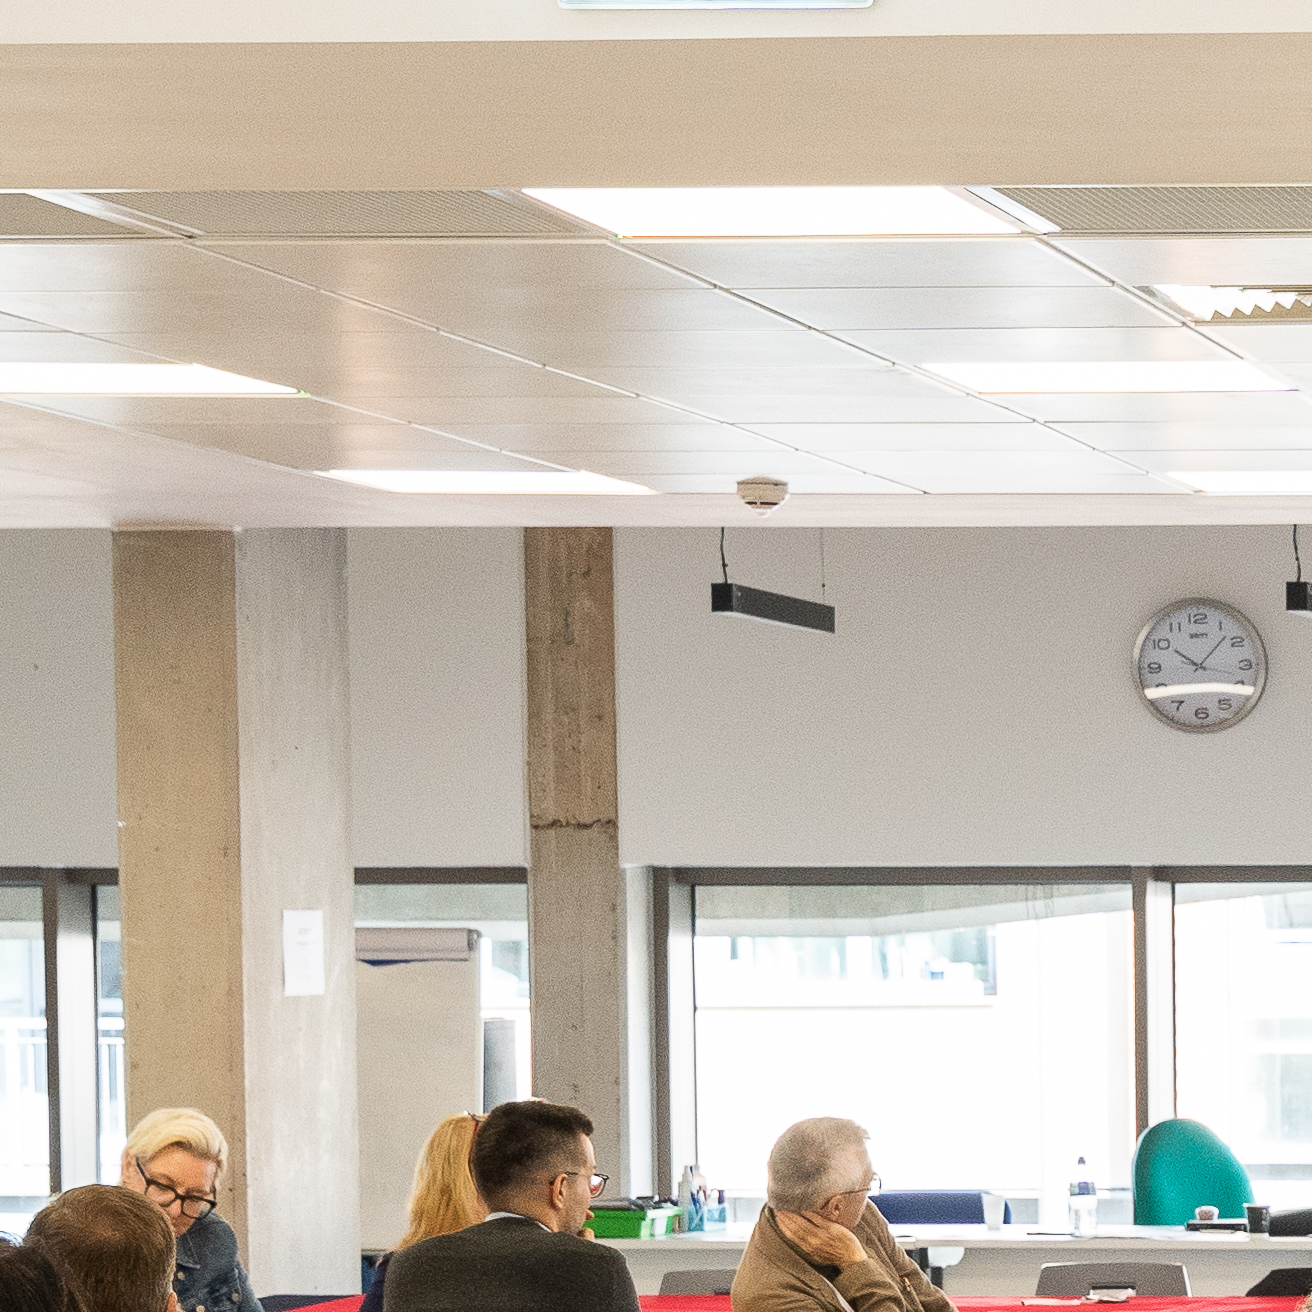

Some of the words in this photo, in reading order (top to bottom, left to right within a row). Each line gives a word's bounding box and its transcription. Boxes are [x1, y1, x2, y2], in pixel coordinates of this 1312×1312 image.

[1188, 612, 1208, 625] 12
[1169, 622, 1182, 633] 11
[1152, 638, 1171, 650] 10
[1230, 636, 1245, 648] 2
[1148, 662, 1162, 674] 9
[1238, 659, 1252, 671] 3
[1171, 700, 1185, 711] 7
[1218, 698, 1232, 711] 5
[1195, 707, 1209, 720] 6
